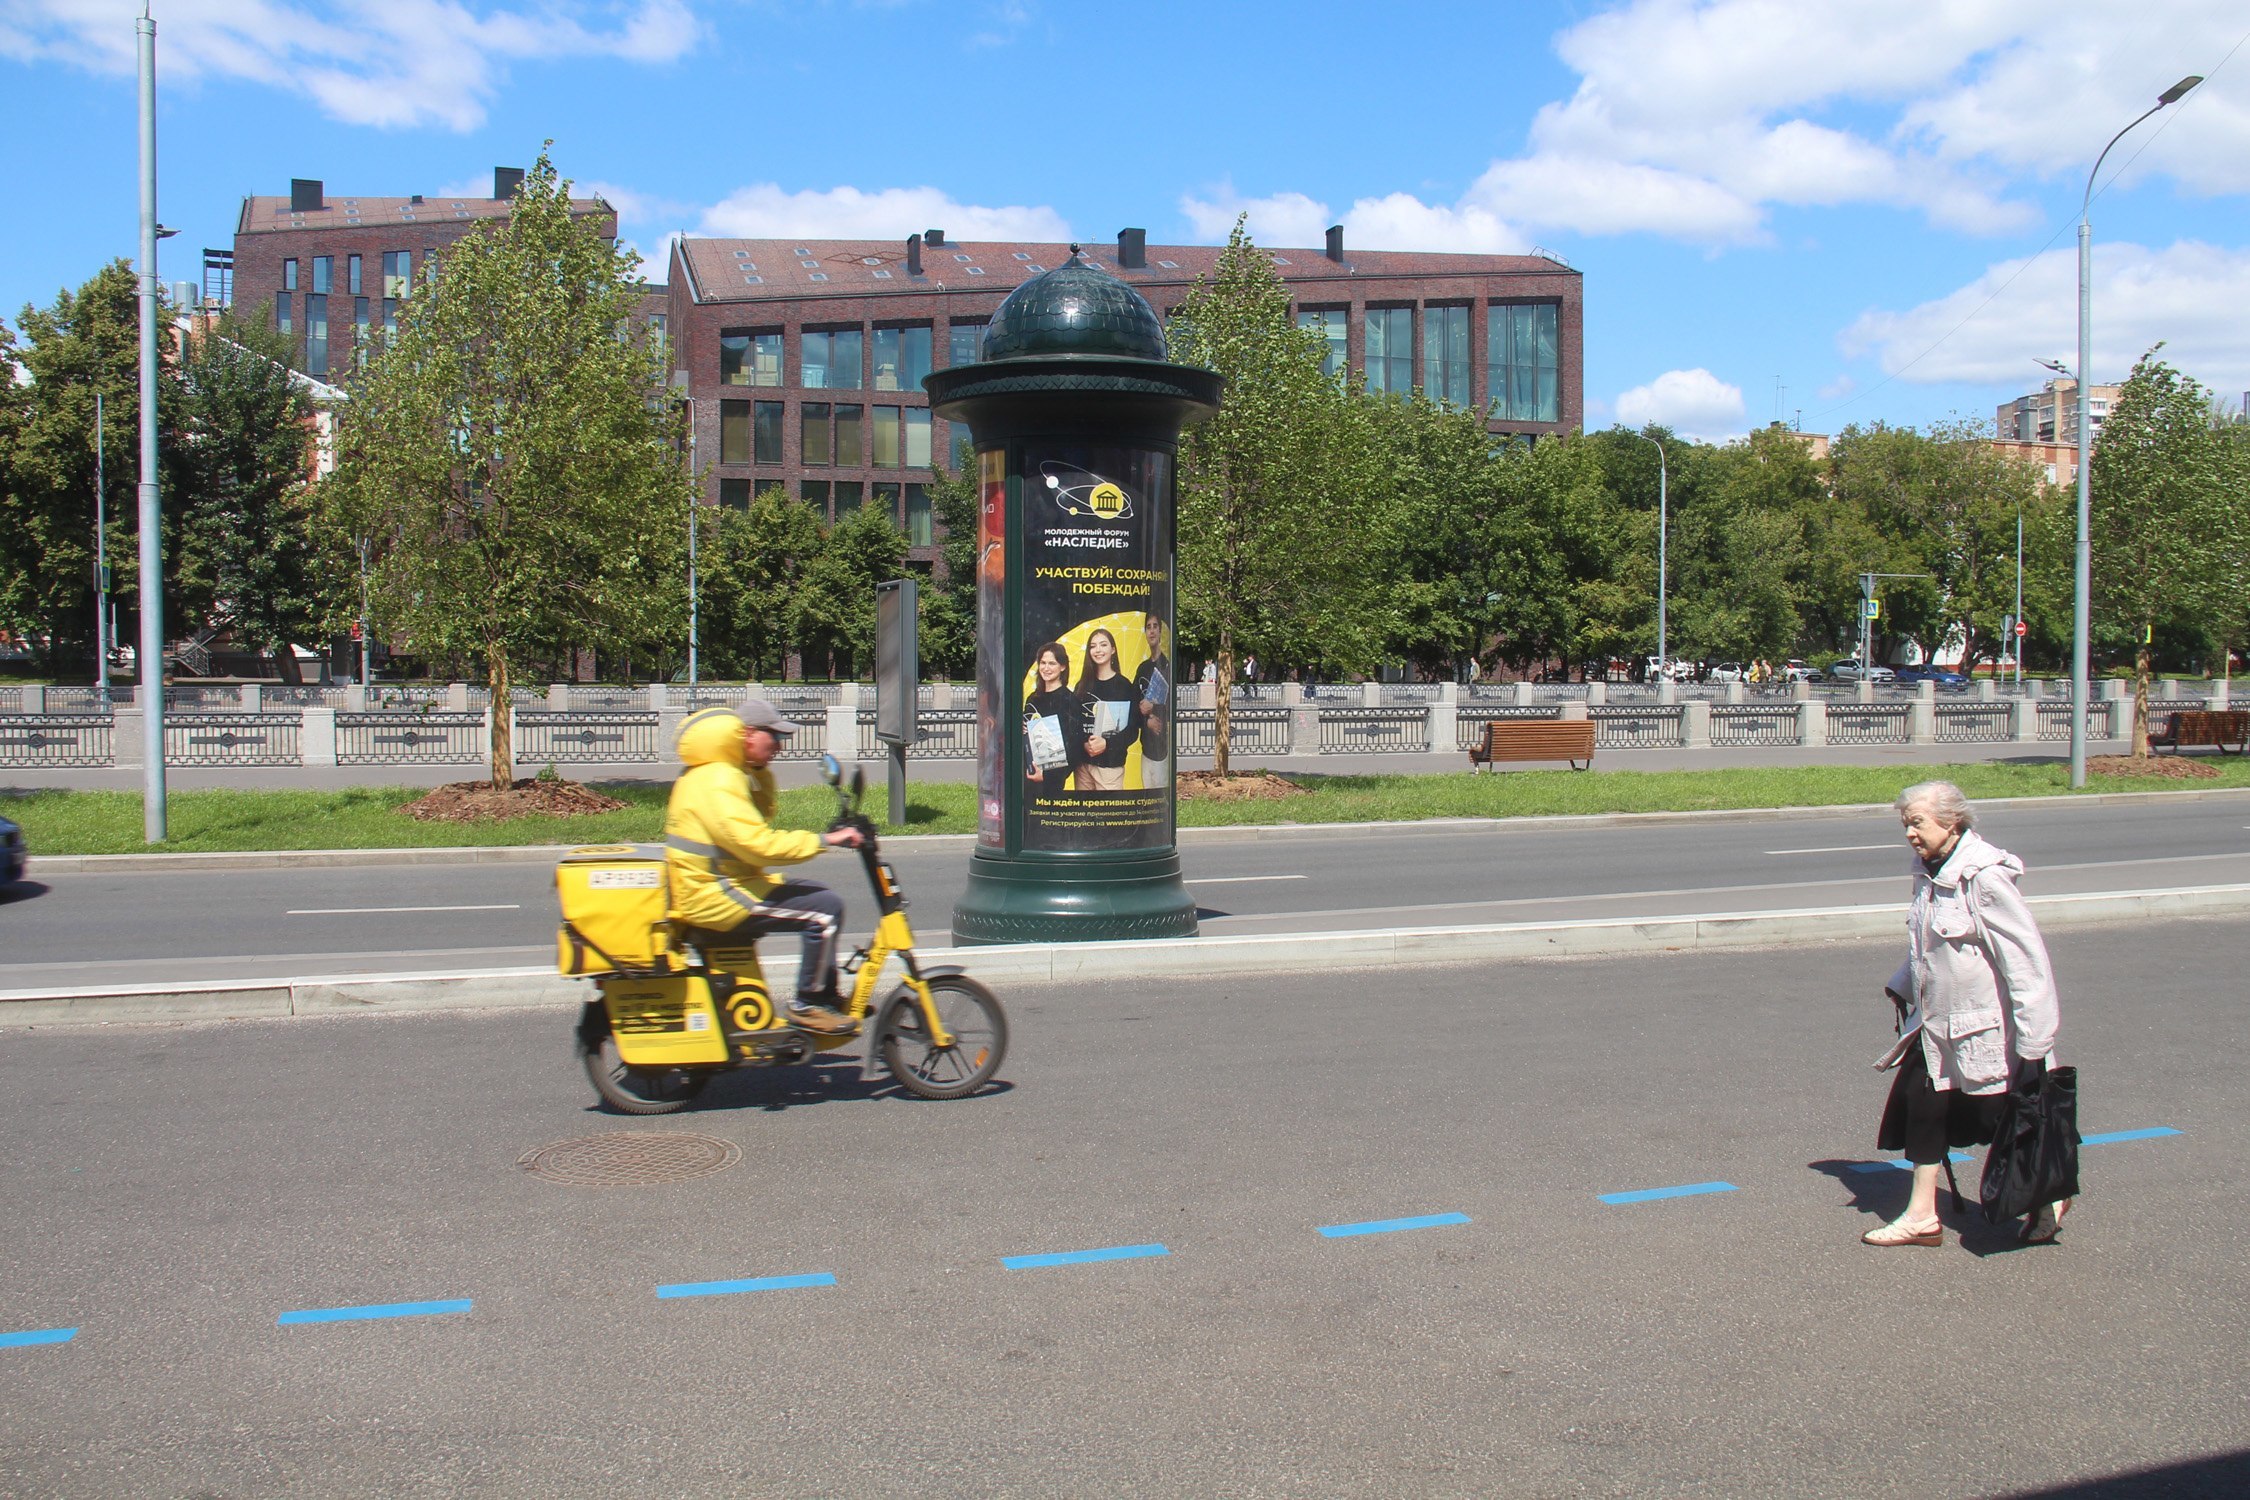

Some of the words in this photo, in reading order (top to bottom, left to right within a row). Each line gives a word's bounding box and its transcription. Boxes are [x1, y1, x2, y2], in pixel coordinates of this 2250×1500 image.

[1044, 528, 1102, 536] МОЛОДЕЖНЫЙ
[1103, 529, 1130, 537] ФОРУМ
[1044, 537, 1130, 549] «НАСЛЕДИЕ»
[1035, 565, 1113, 579] УЧАСТВУЙ!
[1072, 582, 1151, 597] ПОБЕЖДАЙ!
[1035, 798, 1051, 806] Мы
[1082, 799, 1136, 808] креативных
[1040, 819, 1095, 828] Регистрируйся
